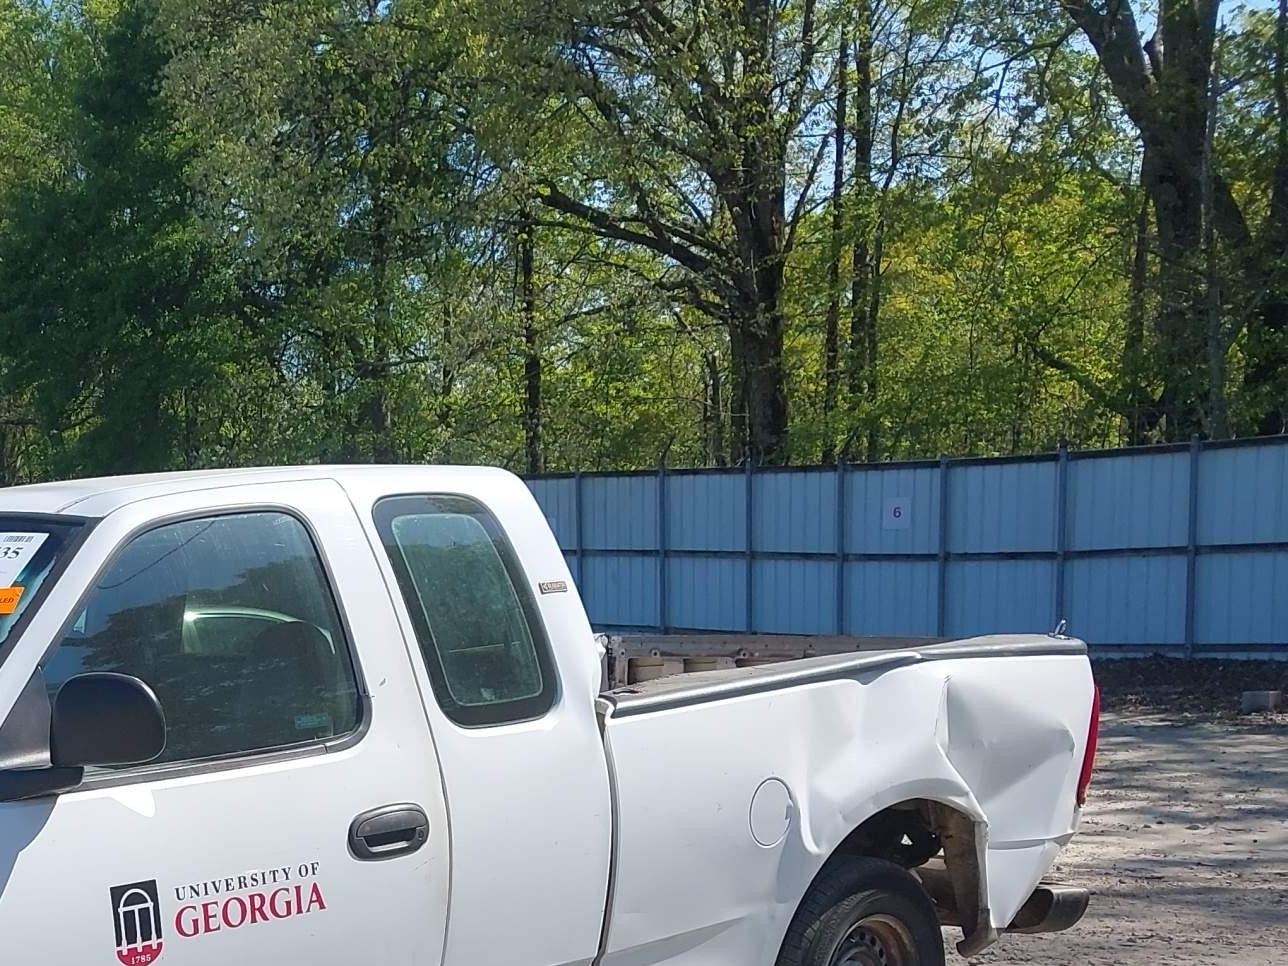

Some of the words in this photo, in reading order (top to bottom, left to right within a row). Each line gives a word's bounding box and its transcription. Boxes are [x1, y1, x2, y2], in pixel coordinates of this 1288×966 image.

[892, 506, 902, 518] 6
[175, 866, 293, 901] UNIVERSITY
[298, 861, 320, 878] OF
[174, 881, 327, 938] GEORGIA
[130, 953, 153, 966] 1785
